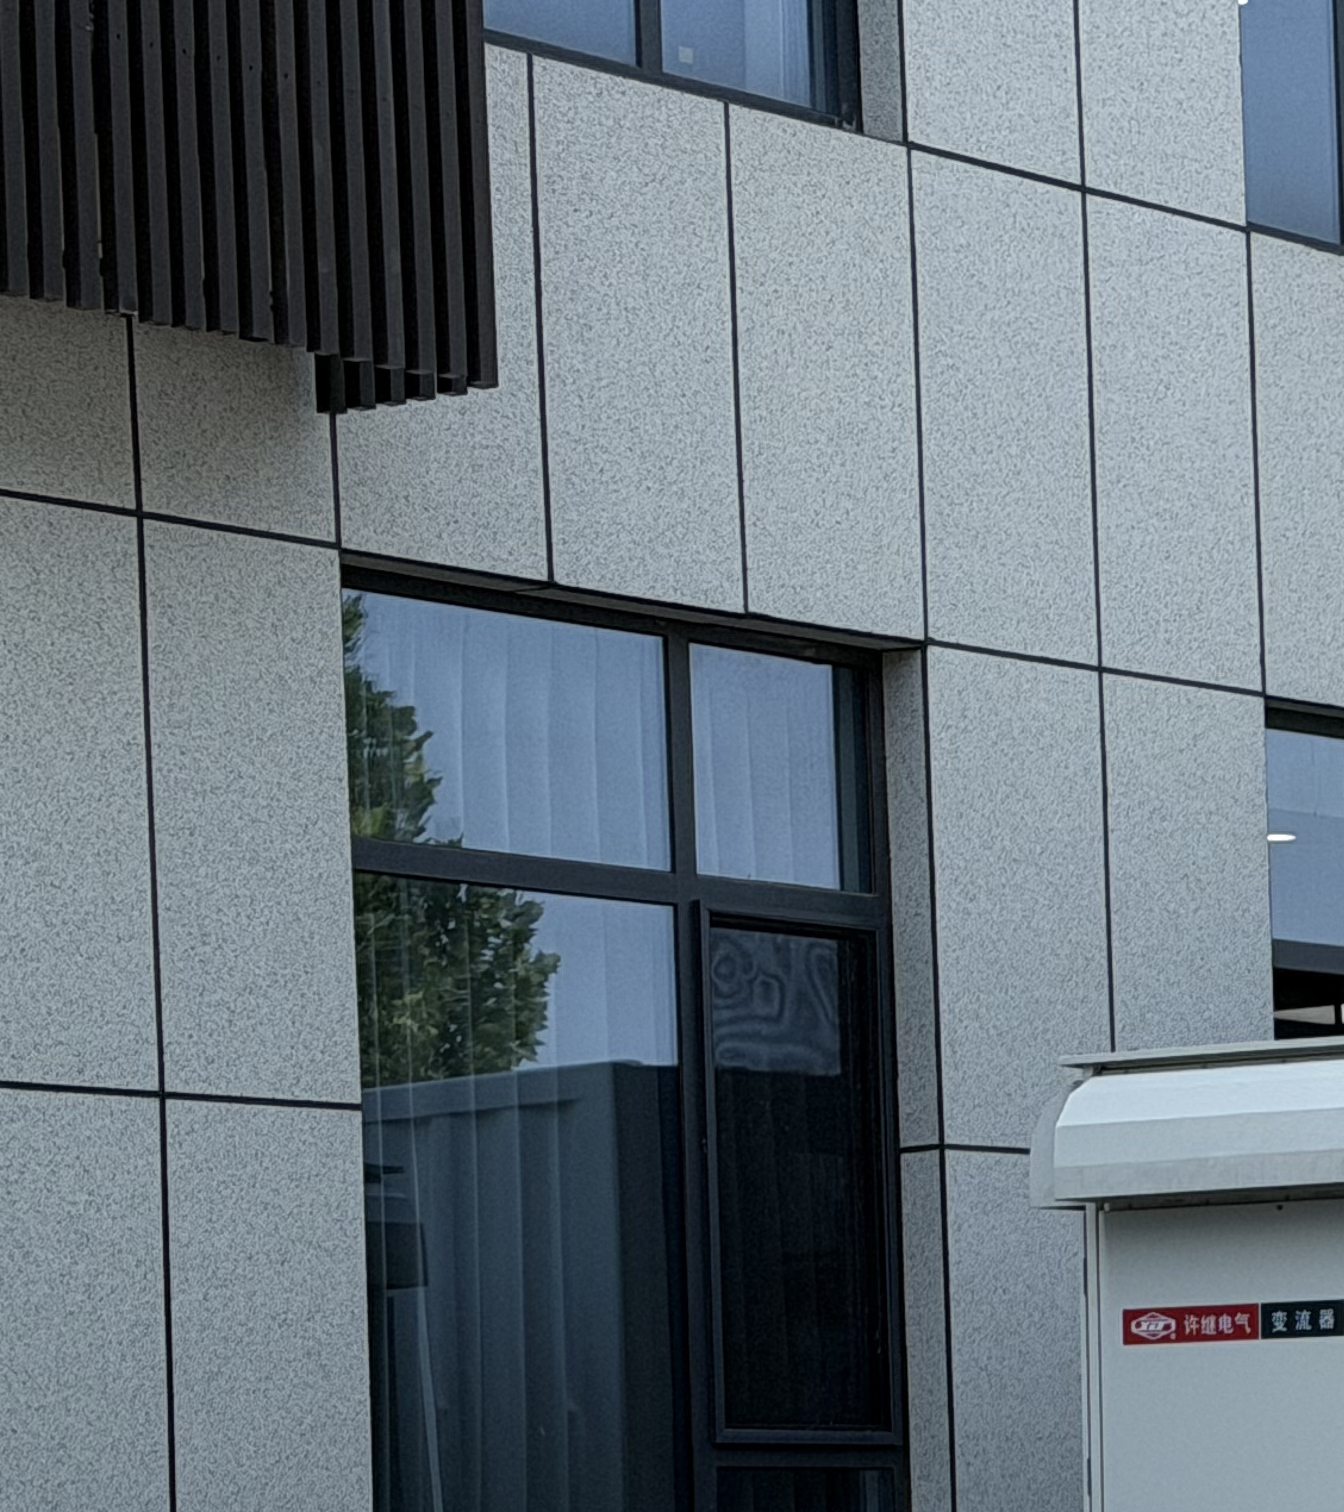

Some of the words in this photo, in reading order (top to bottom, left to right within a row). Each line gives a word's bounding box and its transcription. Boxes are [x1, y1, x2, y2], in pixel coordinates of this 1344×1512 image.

[1184, 1312, 1252, 1336] 许继电气
[1271, 1308, 1336, 1333] 变流器
